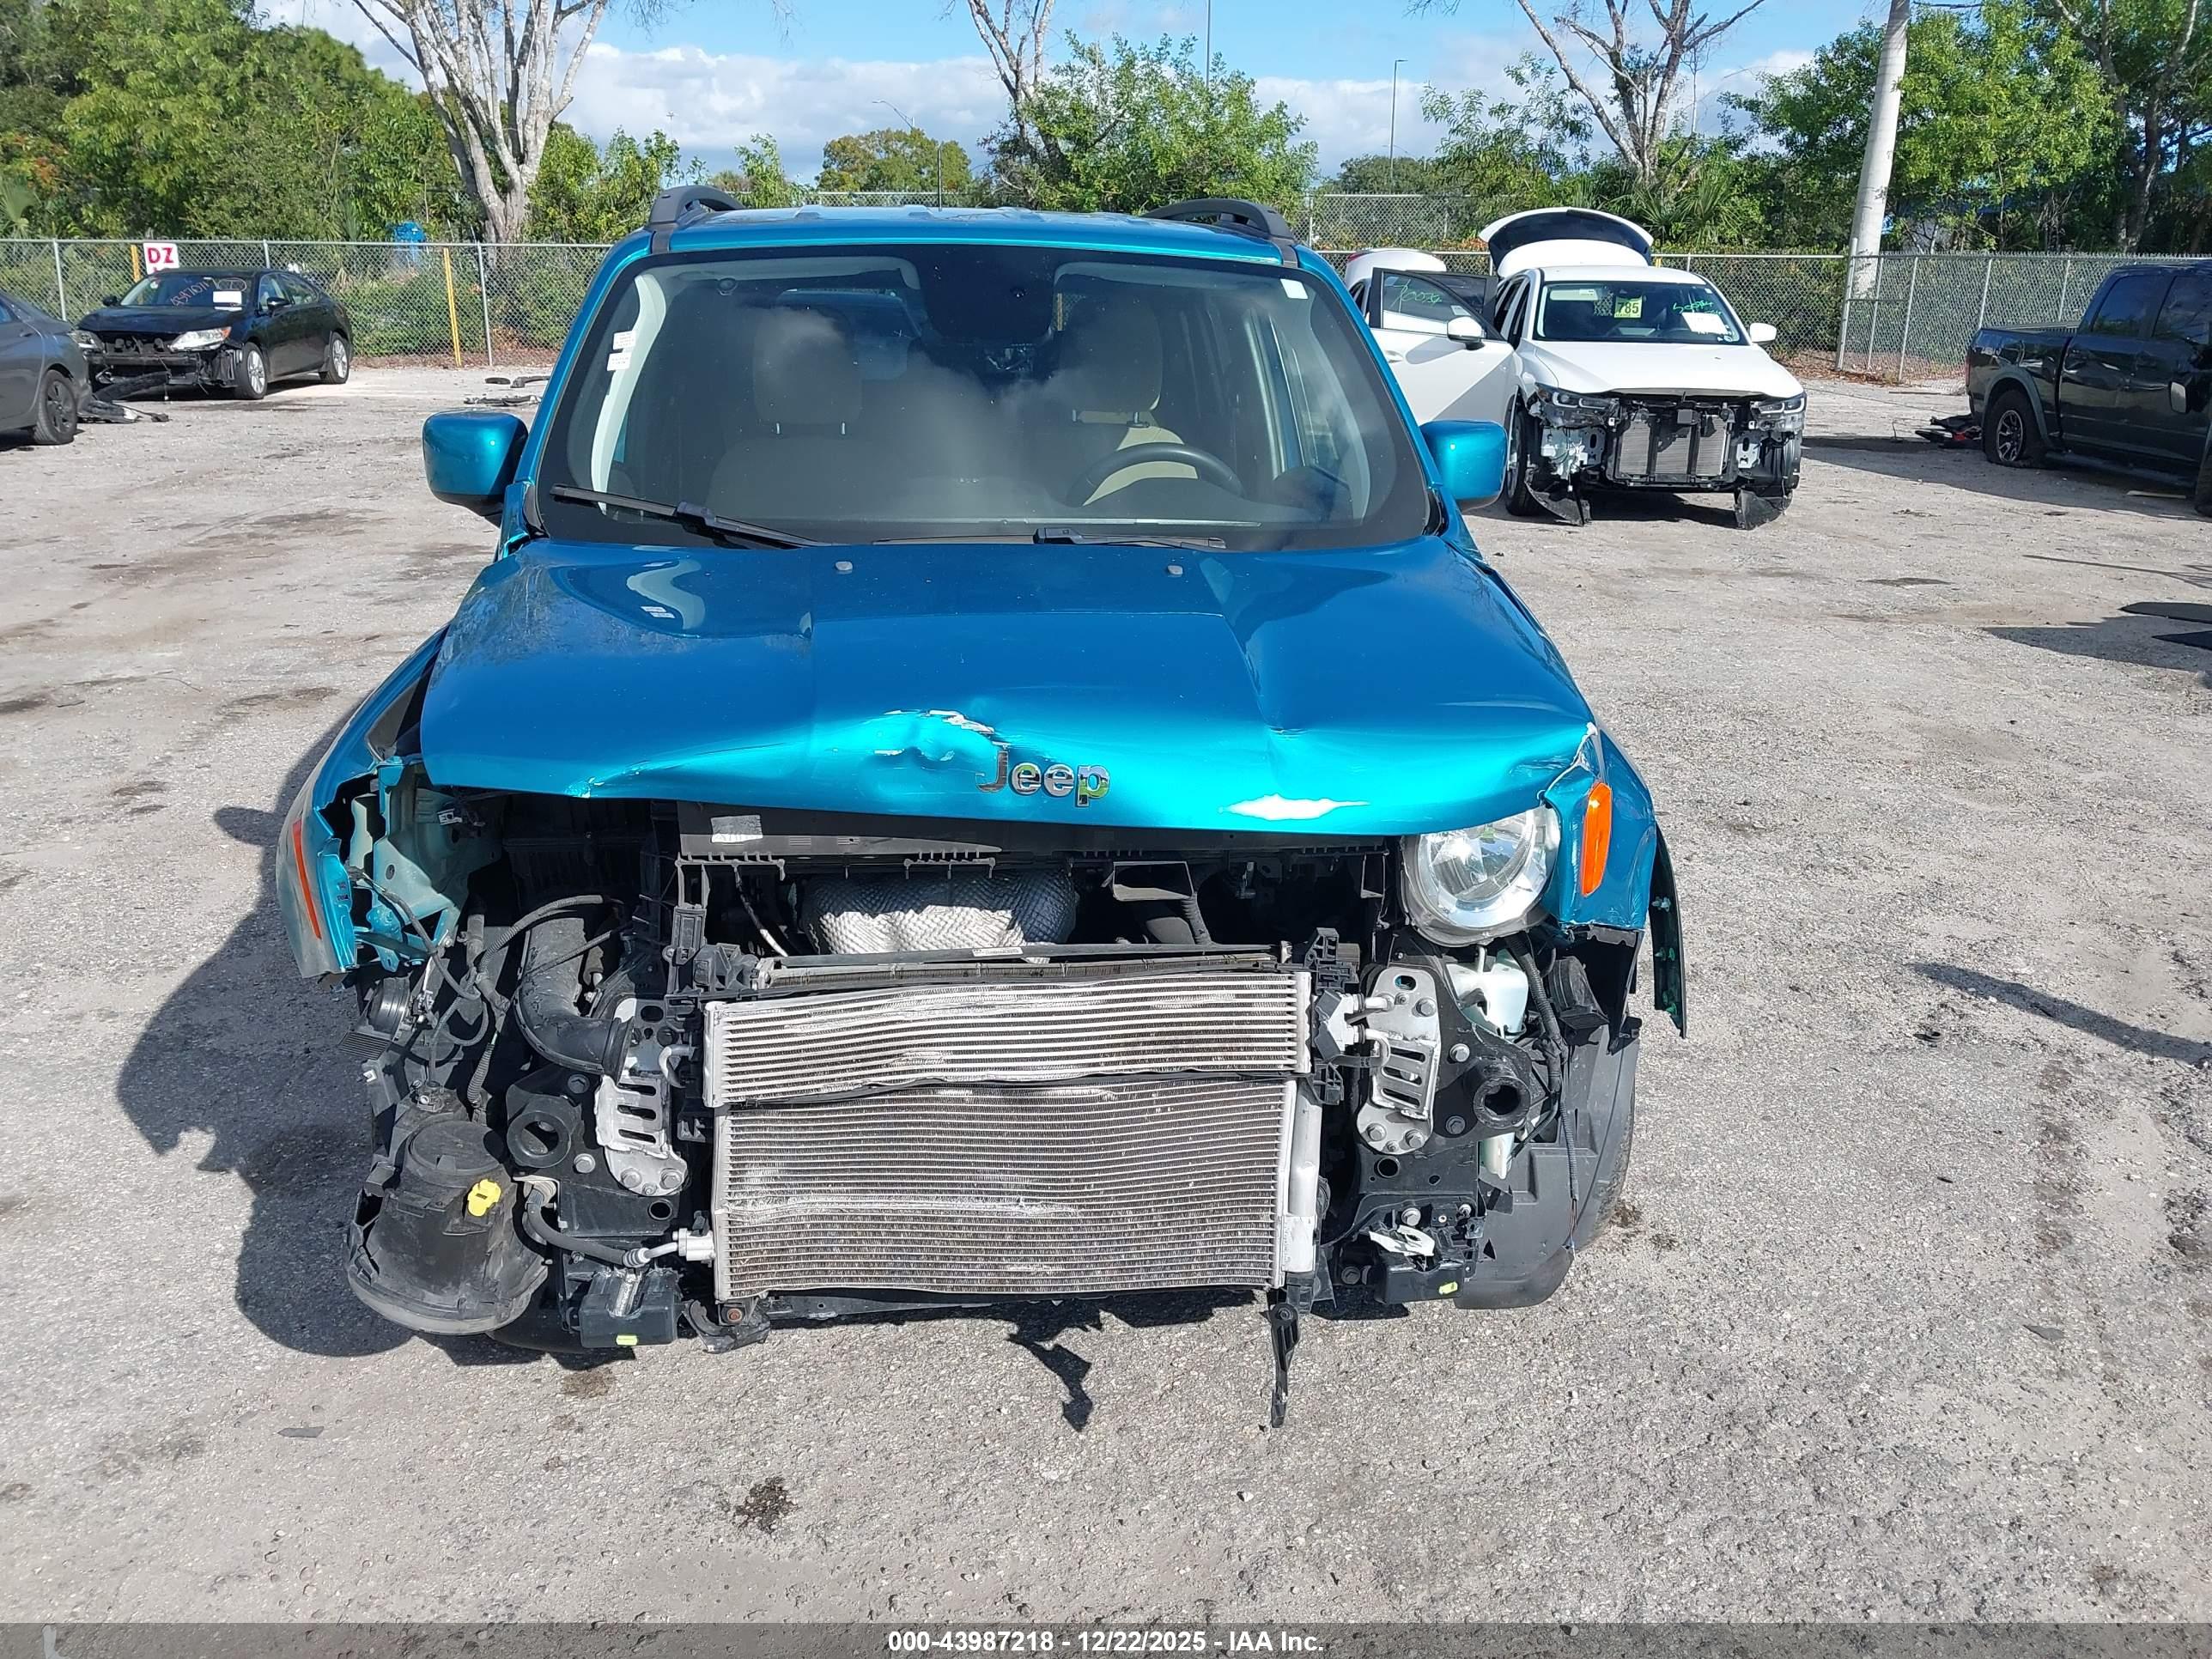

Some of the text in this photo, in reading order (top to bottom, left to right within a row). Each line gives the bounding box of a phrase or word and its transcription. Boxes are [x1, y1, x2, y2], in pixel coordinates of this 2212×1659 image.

[147, 246, 174, 264] DZ
[1617, 301, 1639, 314] 785
[975, 750, 1111, 807] Jeep
